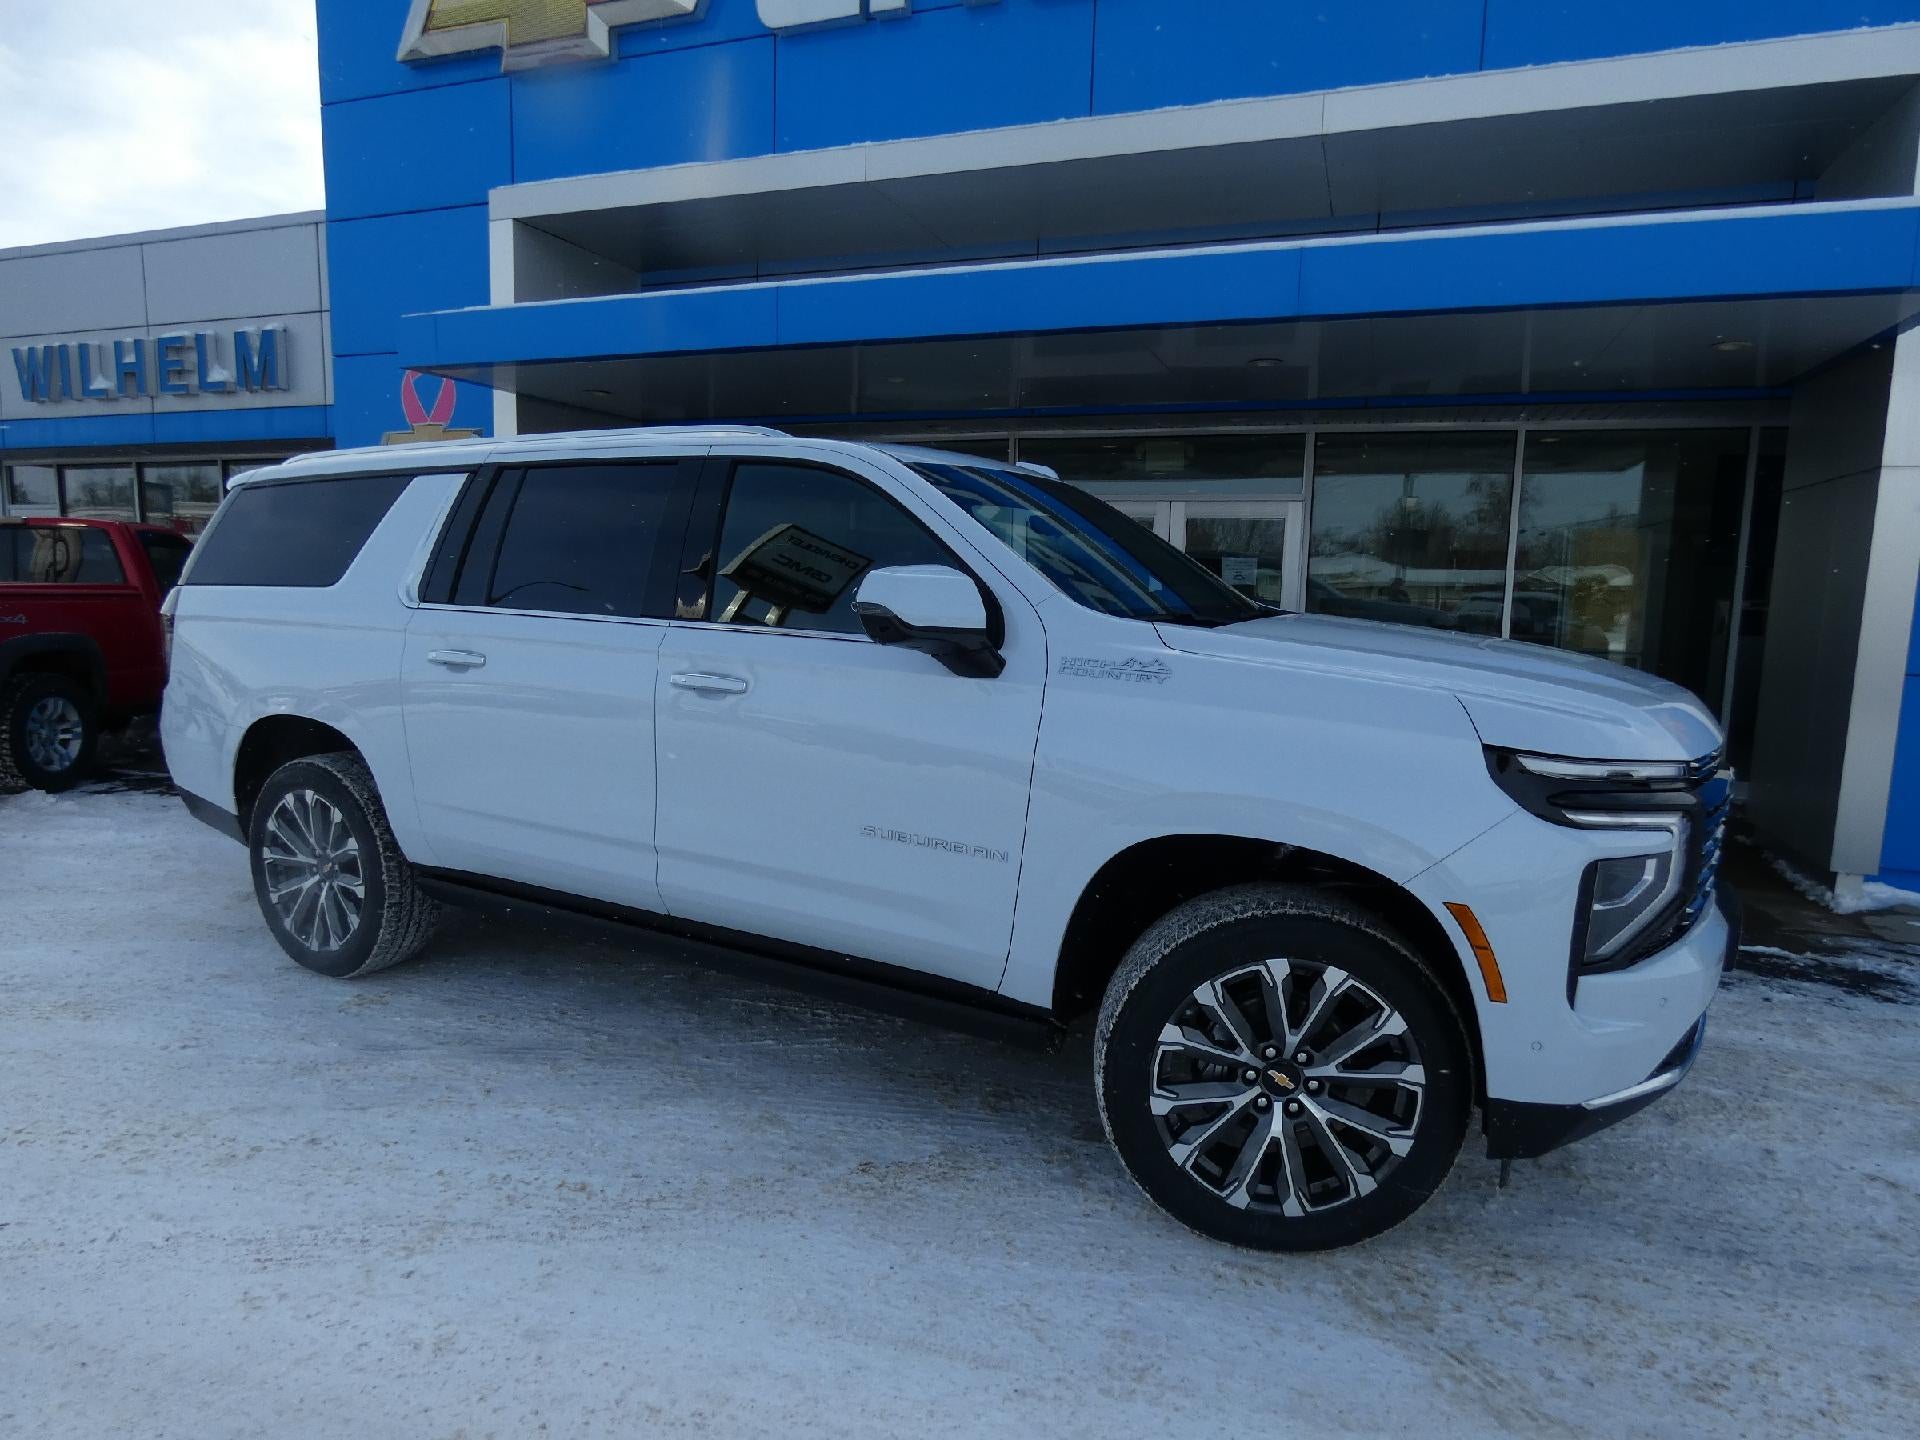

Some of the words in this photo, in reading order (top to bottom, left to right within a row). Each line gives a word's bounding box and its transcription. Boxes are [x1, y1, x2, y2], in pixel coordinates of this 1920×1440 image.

[12, 326, 287, 402] WILHELM
[0, 613, 28, 625] x4
[1061, 657, 1118, 668] HIGH
[1060, 666, 1171, 684] COUNTRY
[861, 825, 1009, 863] SUBURBAN
